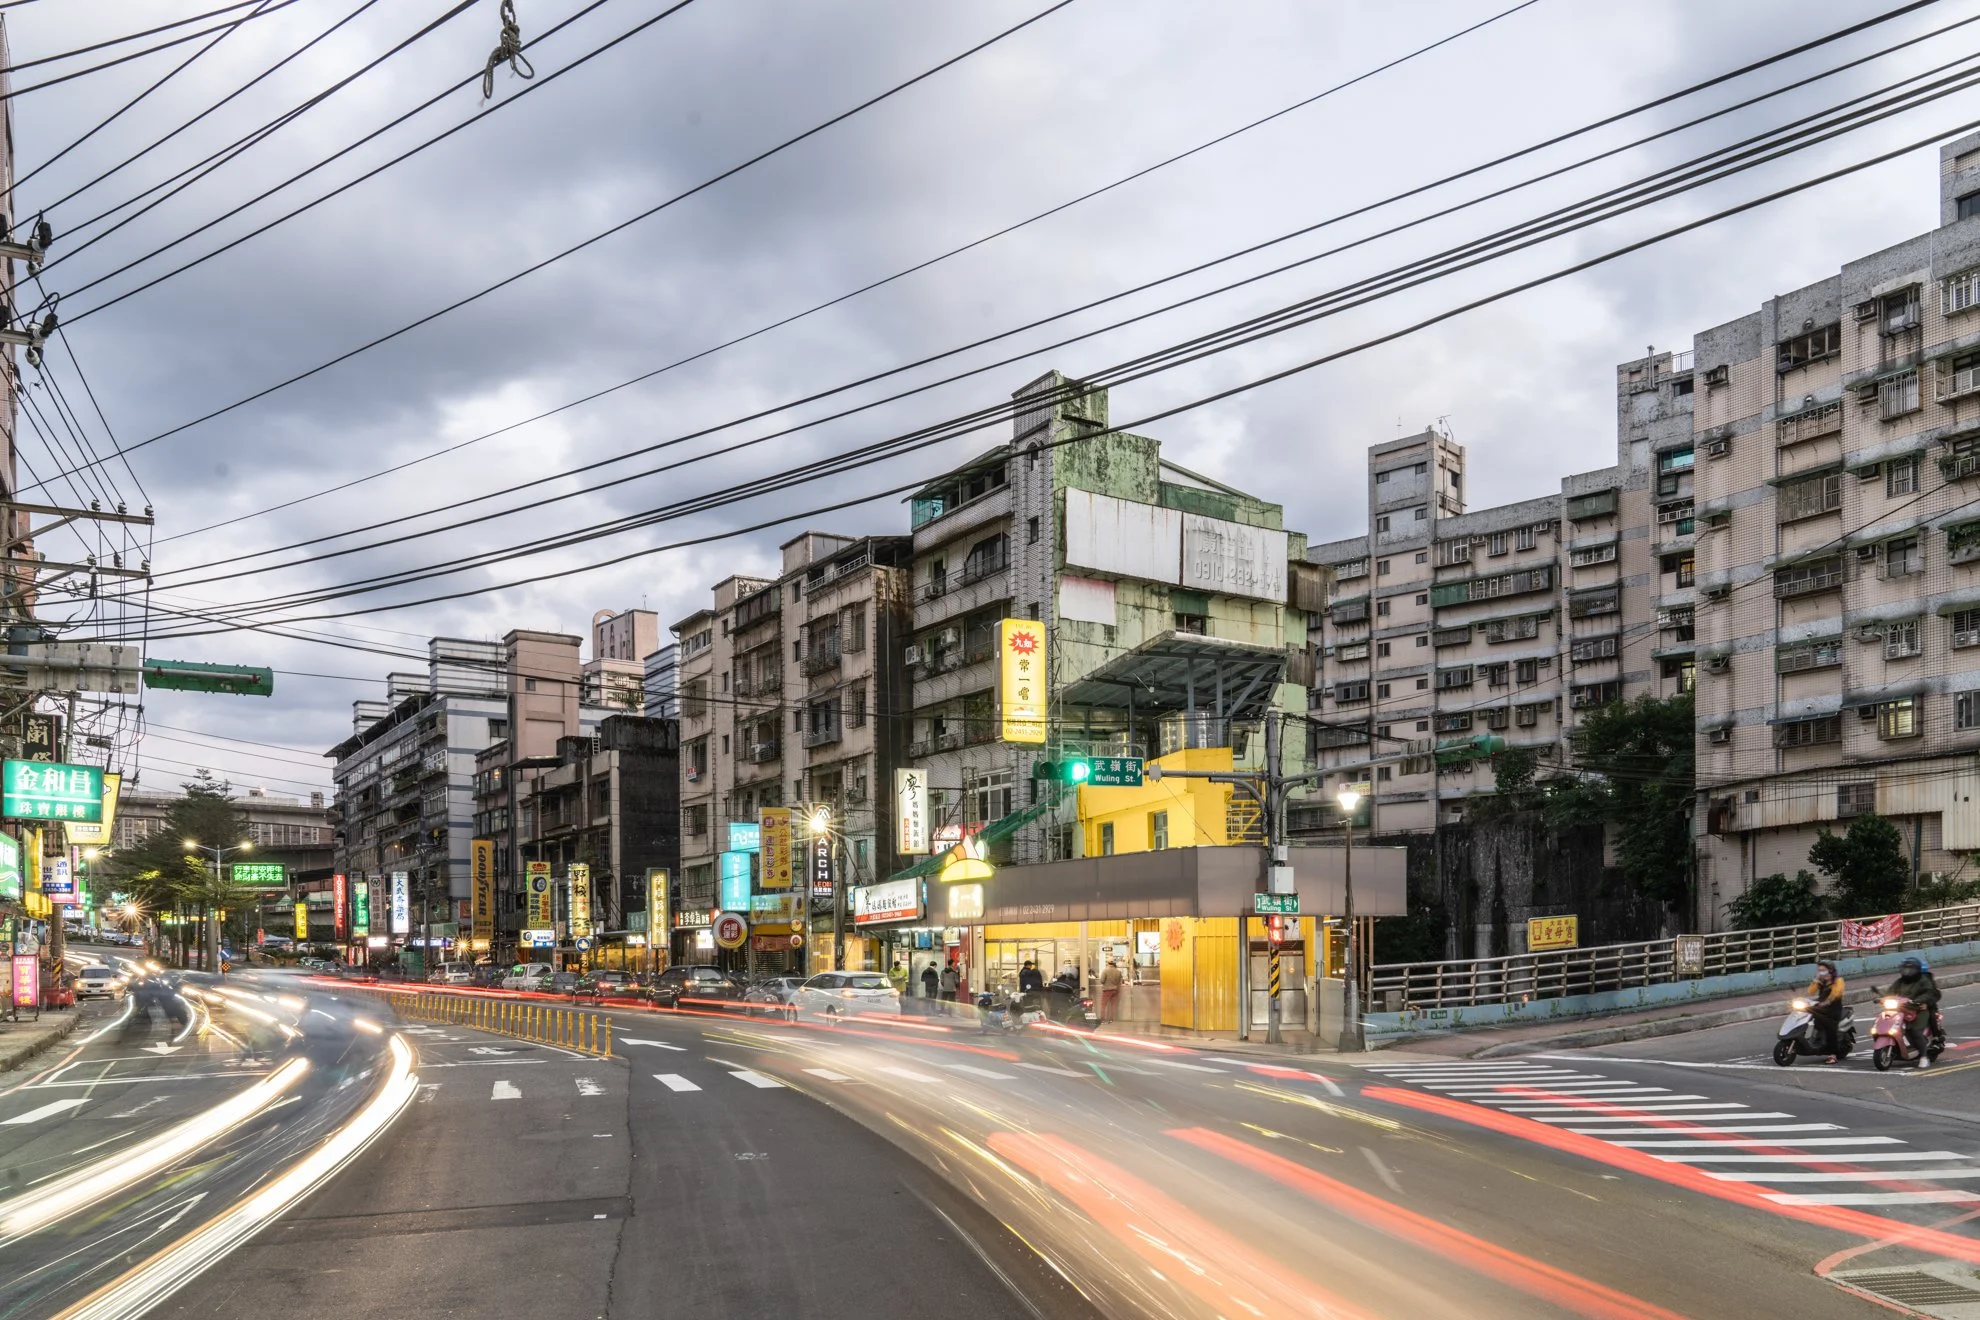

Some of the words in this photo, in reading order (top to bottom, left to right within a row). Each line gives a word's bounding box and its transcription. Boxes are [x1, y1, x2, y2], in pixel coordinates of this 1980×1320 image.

[1015, 637, 1033, 648] 九如
[1094, 760, 1137, 772] 武嶺街
[15, 765, 91, 794] 金和昌
[1095, 774, 1120, 784] Wuling
[1125, 775, 1136, 783] St.
[42, 866, 53, 882] 世界
[478, 846, 489, 916] GOODYEAR
